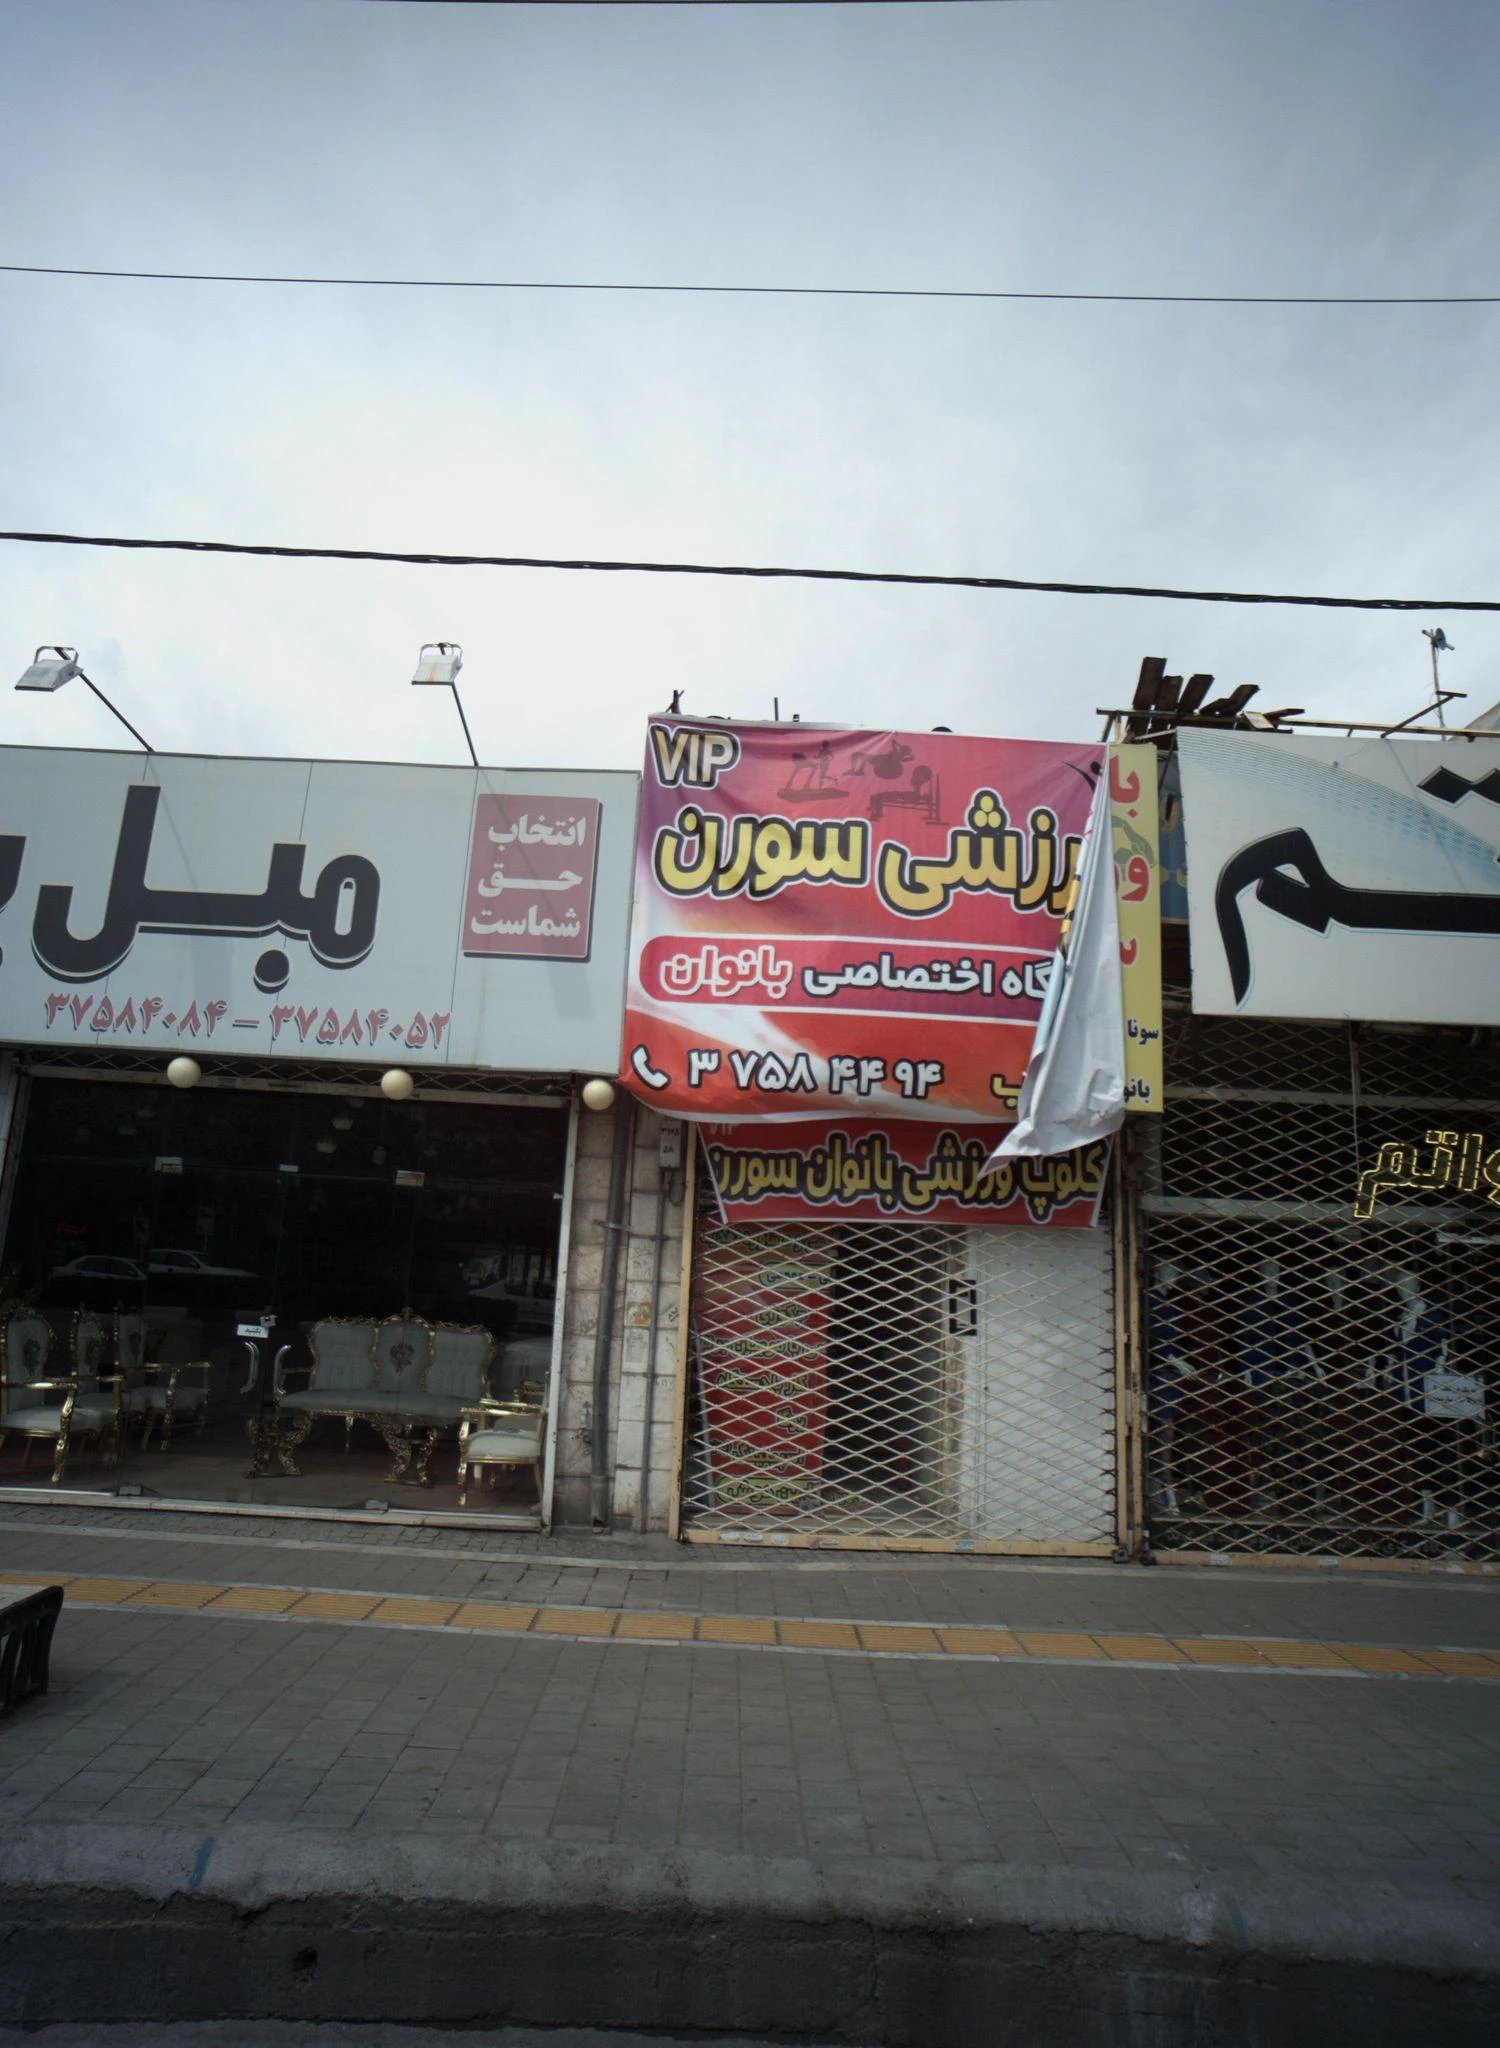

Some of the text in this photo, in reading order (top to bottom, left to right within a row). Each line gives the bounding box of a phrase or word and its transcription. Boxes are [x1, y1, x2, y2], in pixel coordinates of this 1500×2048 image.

[651, 725, 736, 786] VIP
[488, 814, 586, 852] انتخاب
[657, 792, 1083, 914] رزشی سورن
[31, 785, 380, 992] مبل
[478, 862, 583, 898] حق
[471, 904, 580, 937] شماست
[659, 946, 1054, 1000] گاه اختصاصی بانوان
[1127, 1019, 1159, 1045] سونا
[1123, 1078, 1150, 1104] بانو
[708, 1136, 1104, 1218] کلوپ ورزشی بانوان سورن
